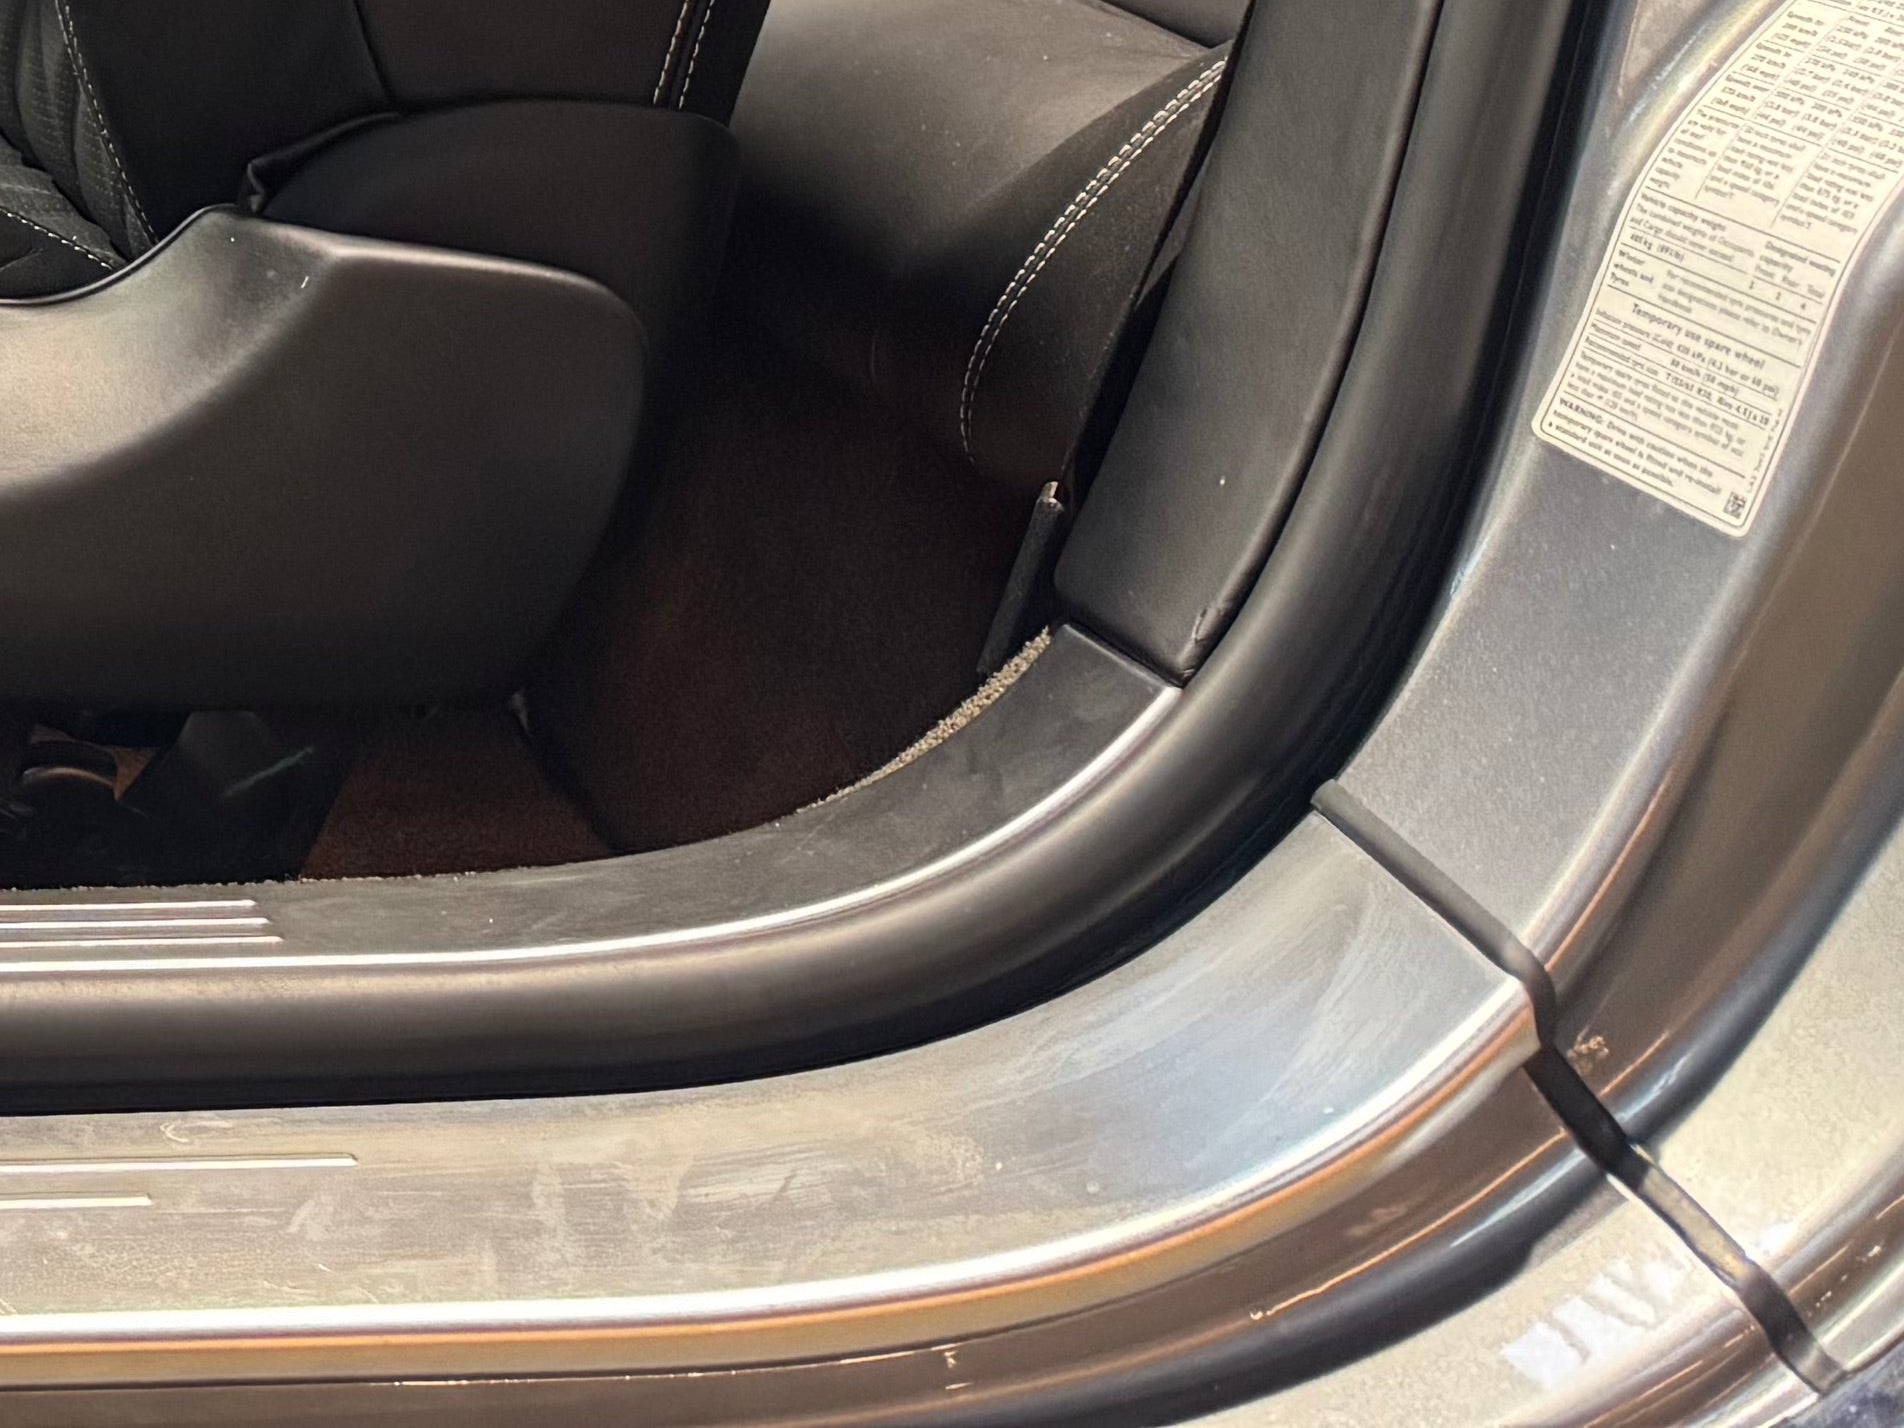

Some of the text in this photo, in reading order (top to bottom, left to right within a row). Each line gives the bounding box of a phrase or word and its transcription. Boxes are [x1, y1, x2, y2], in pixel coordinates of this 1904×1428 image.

[1629, 302, 1683, 336] Temporary
[1683, 328, 1702, 342] use
[1702, 336, 1731, 357] spare
[1733, 348, 1765, 370] wheel
